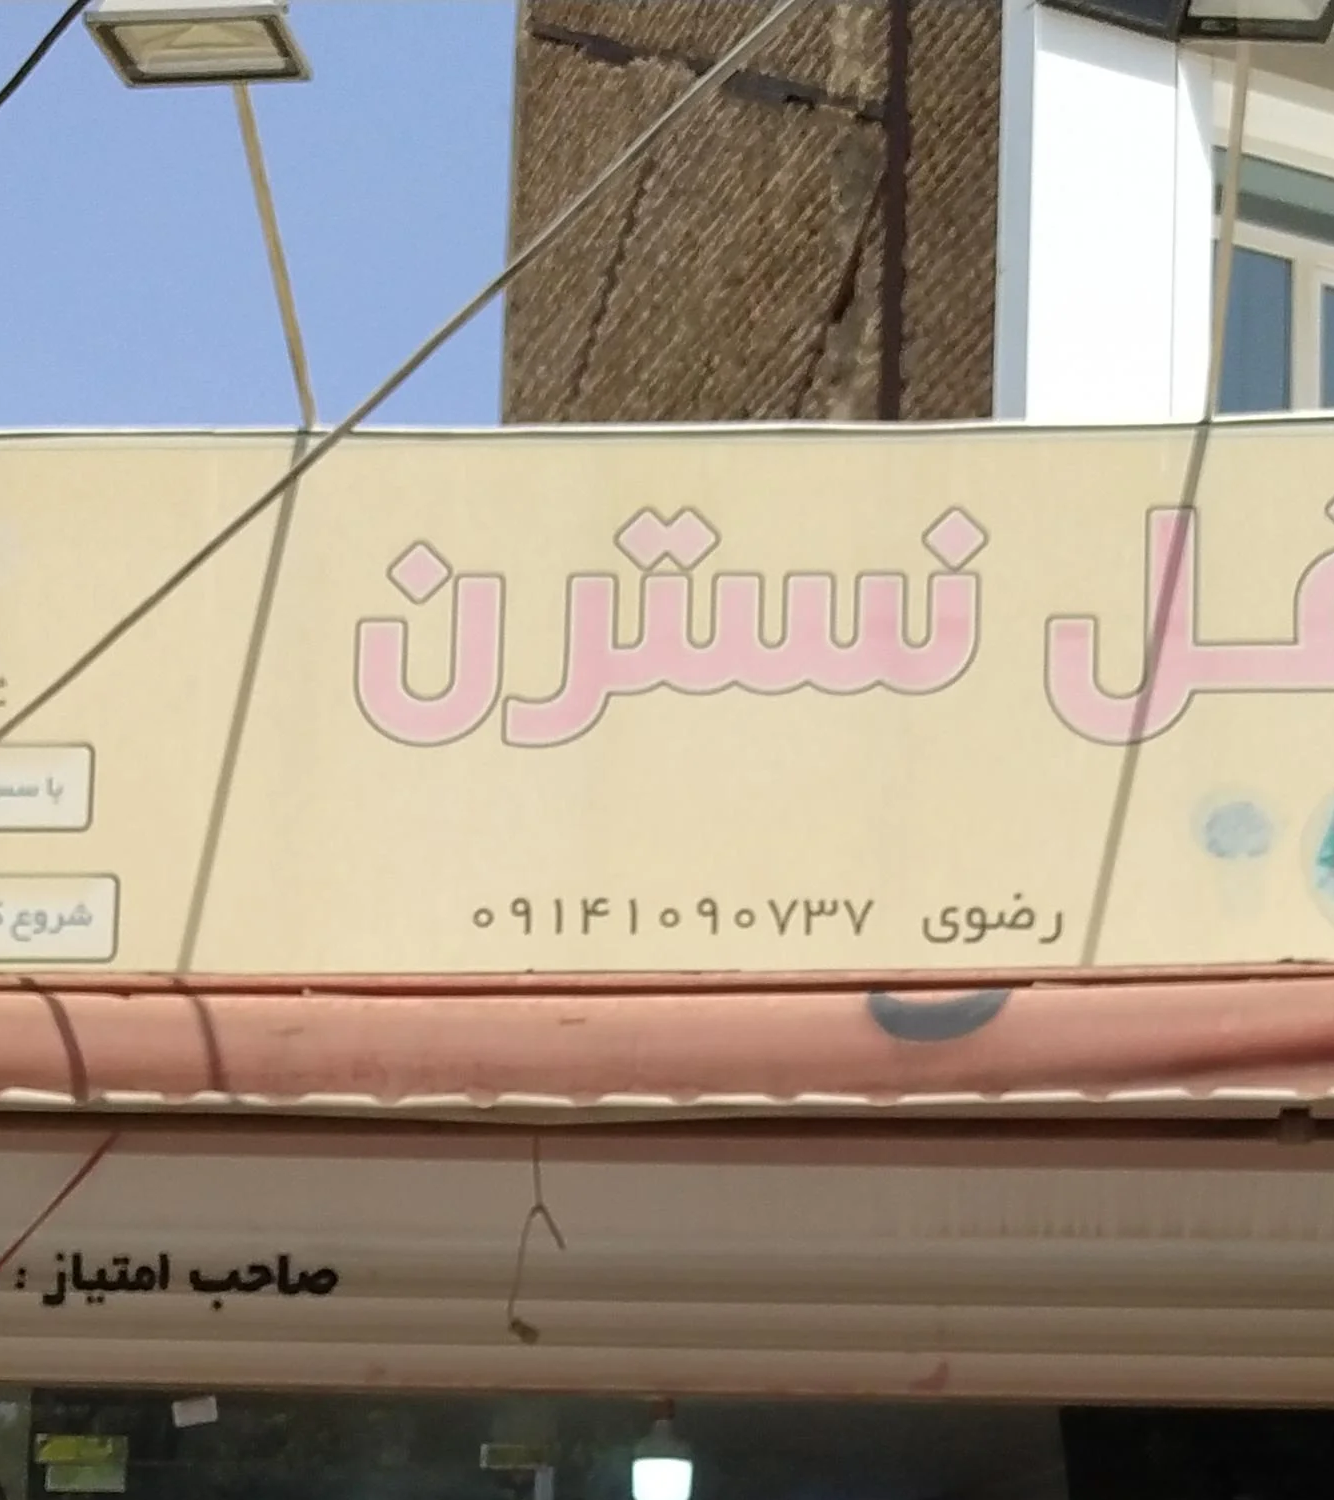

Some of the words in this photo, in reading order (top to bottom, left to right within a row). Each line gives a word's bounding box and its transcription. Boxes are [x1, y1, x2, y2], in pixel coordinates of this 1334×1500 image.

[353, 505, 990, 748] نسترن
[10, 900, 94, 943] شروع
[471, 896, 876, 937] ۰۹۱۴۱۰۹۰۷۳۷
[920, 891, 1065, 945] رضوی
[41, 1252, 170, 1306] امتیاز
[188, 1253, 341, 1311] صاحب
